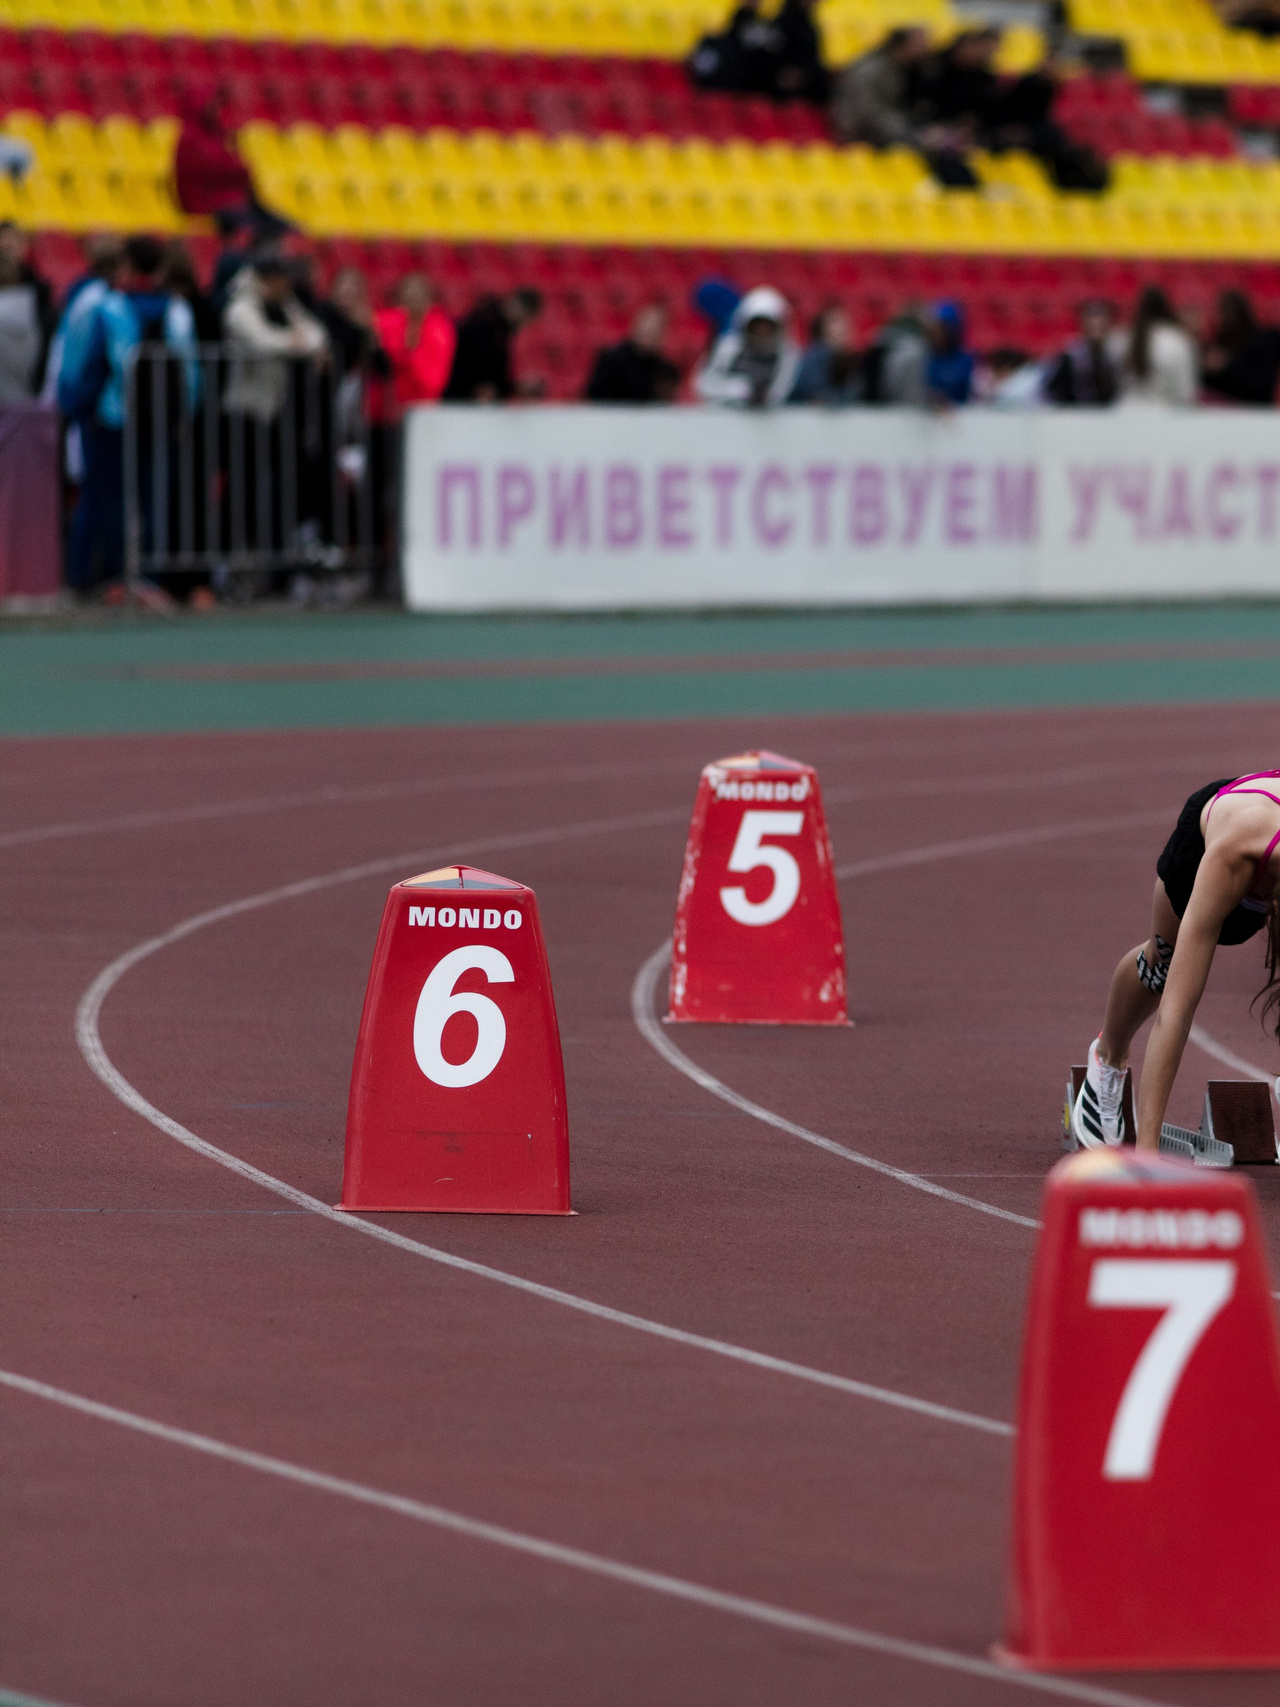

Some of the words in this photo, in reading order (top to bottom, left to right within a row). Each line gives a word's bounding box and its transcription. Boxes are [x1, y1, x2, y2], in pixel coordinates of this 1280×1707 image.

[436, 462, 1036, 548] ПРИВЕТСТВУЕМ
[715, 781, 809, 802] MONDO
[719, 810, 805, 927] 5
[408, 906, 522, 930] MONDO
[413, 945, 516, 1089] 6
[1078, 1208, 1245, 1249] MONDO
[1088, 1259, 1237, 1481] 7
